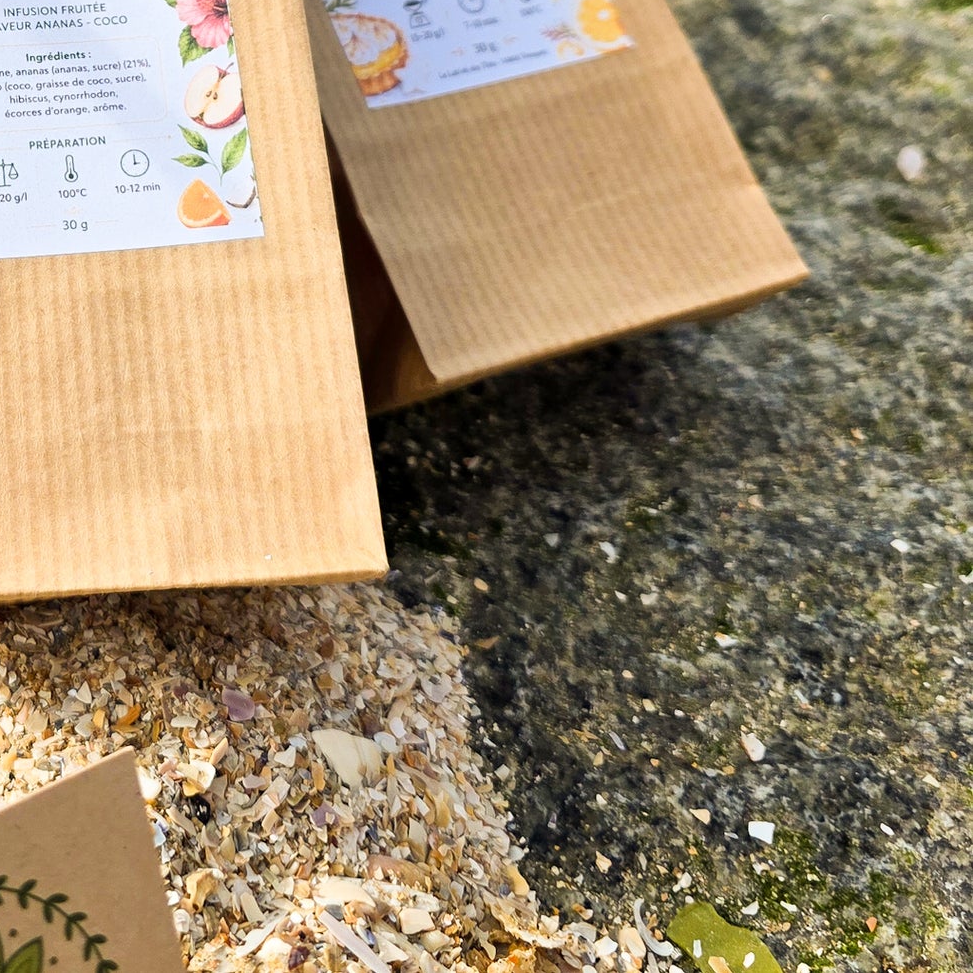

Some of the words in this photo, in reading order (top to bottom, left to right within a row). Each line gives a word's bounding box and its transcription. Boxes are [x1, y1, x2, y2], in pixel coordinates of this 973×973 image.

[3, 6, 58, 17] INFUSION
[61, 1, 107, 15] FRUITÉE
[35, 18, 84, 30] ANANAS
[93, 15, 128, 26] COCO
[25, 51, 86, 64] Ingrédients
[15, 68, 49, 76] ananas
[51, 65, 90, 75] (ananas,
[92, 61, 121, 71] sucre)
[4, 81, 34, 92] (coco,
[35, 79, 70, 91] graisse
[72, 77, 85, 87] de
[87, 77, 113, 86] coco,
[9, 94, 51, 104] hibiscus,
[53, 89, 119, 103] cynorrhodon,
[4, 109, 42, 118] écorces
[44, 106, 90, 116] d'orange,
[92, 102, 127, 112] arôme.
[29, 135, 106, 150] PRÉPARATION
[58, 188, 88, 198] 100°C
[115, 184, 141, 194] 10-12
[142, 182, 161, 192] min
[14, 192, 28, 204] g/l
[62, 219, 77, 230] 30
[80, 221, 88, 231] g
